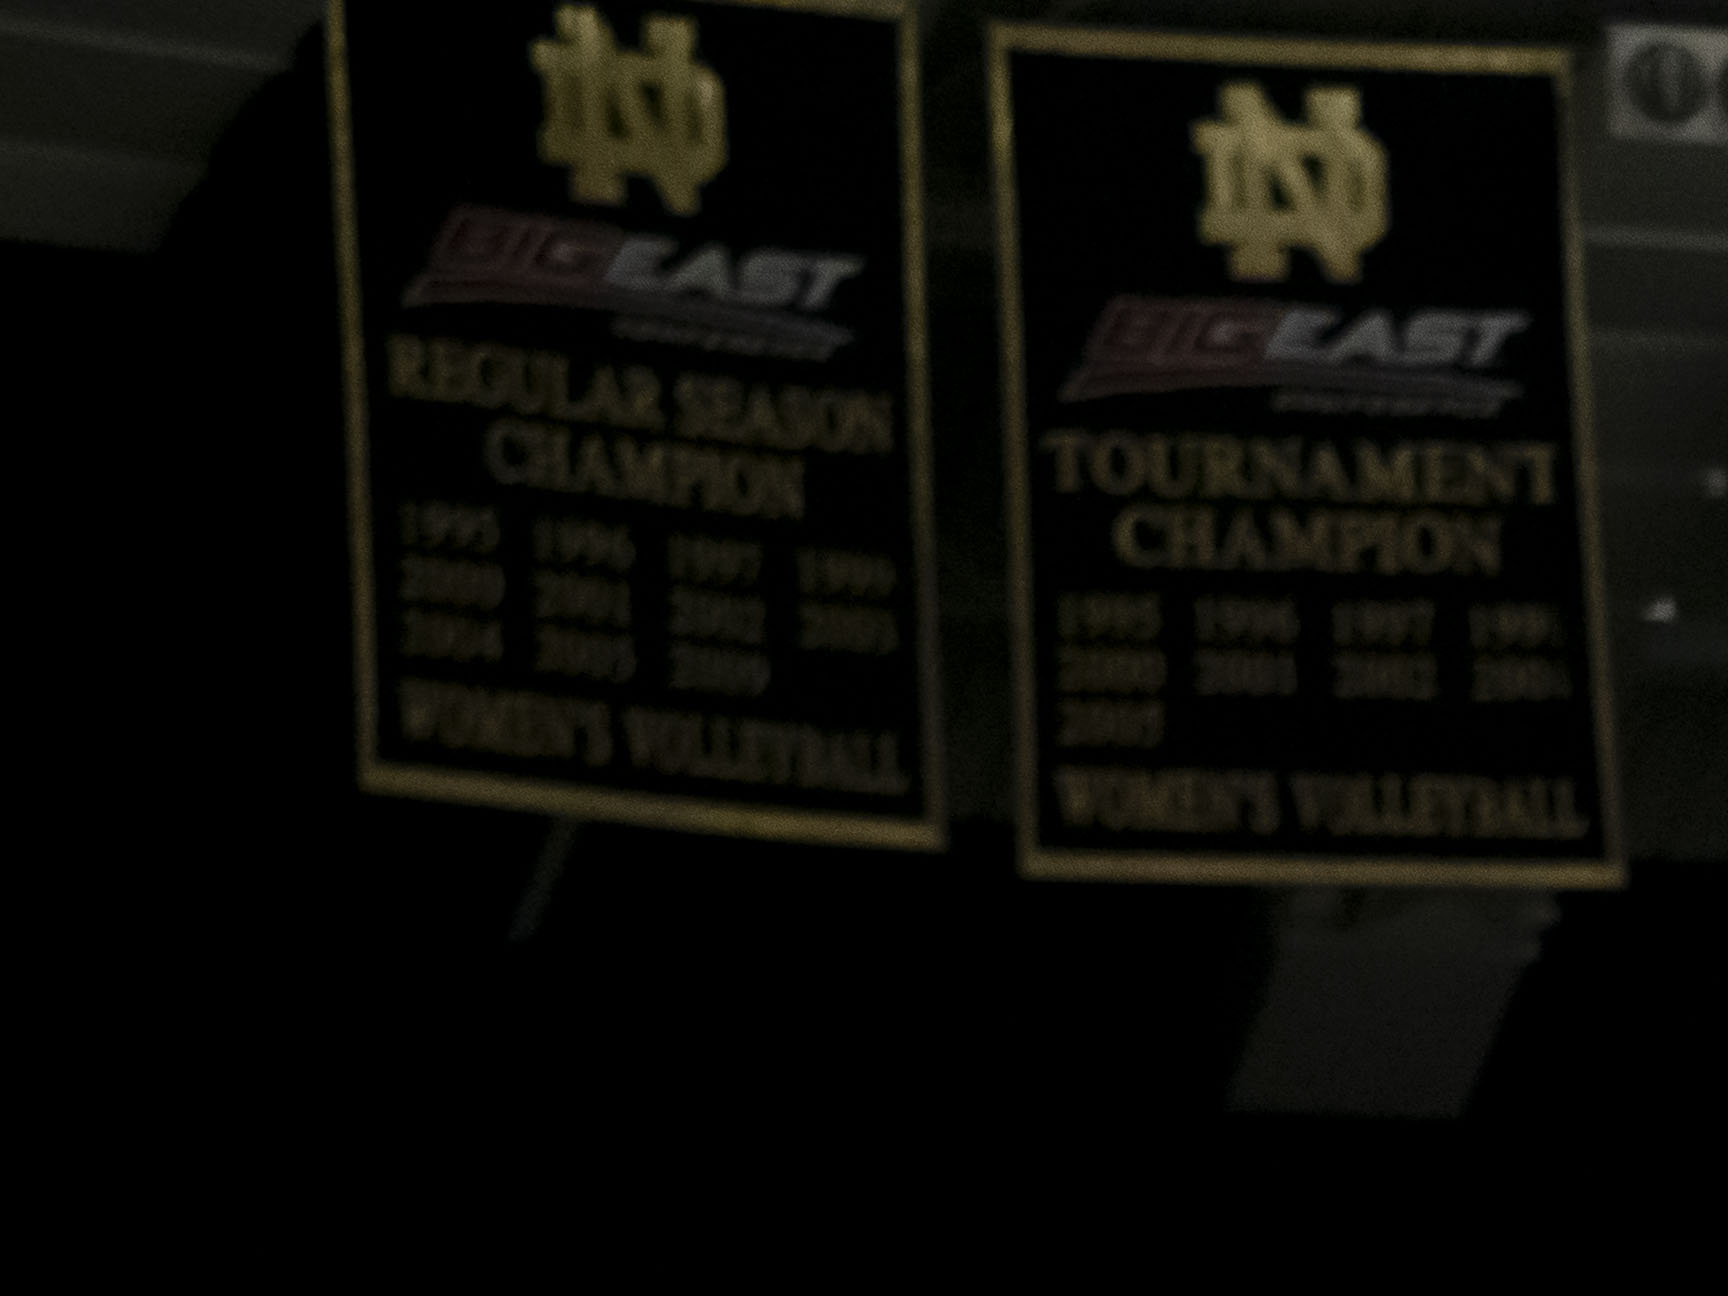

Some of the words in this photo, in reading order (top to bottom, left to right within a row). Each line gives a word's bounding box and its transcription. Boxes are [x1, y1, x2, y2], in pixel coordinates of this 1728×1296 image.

[387, 335, 664, 430] REGULAR
[673, 373, 895, 453] SEASON
[485, 423, 803, 518] CHAMPION
[1041, 430, 1558, 505] TOURNAMENT
[1113, 505, 1503, 575] CHAMPION
